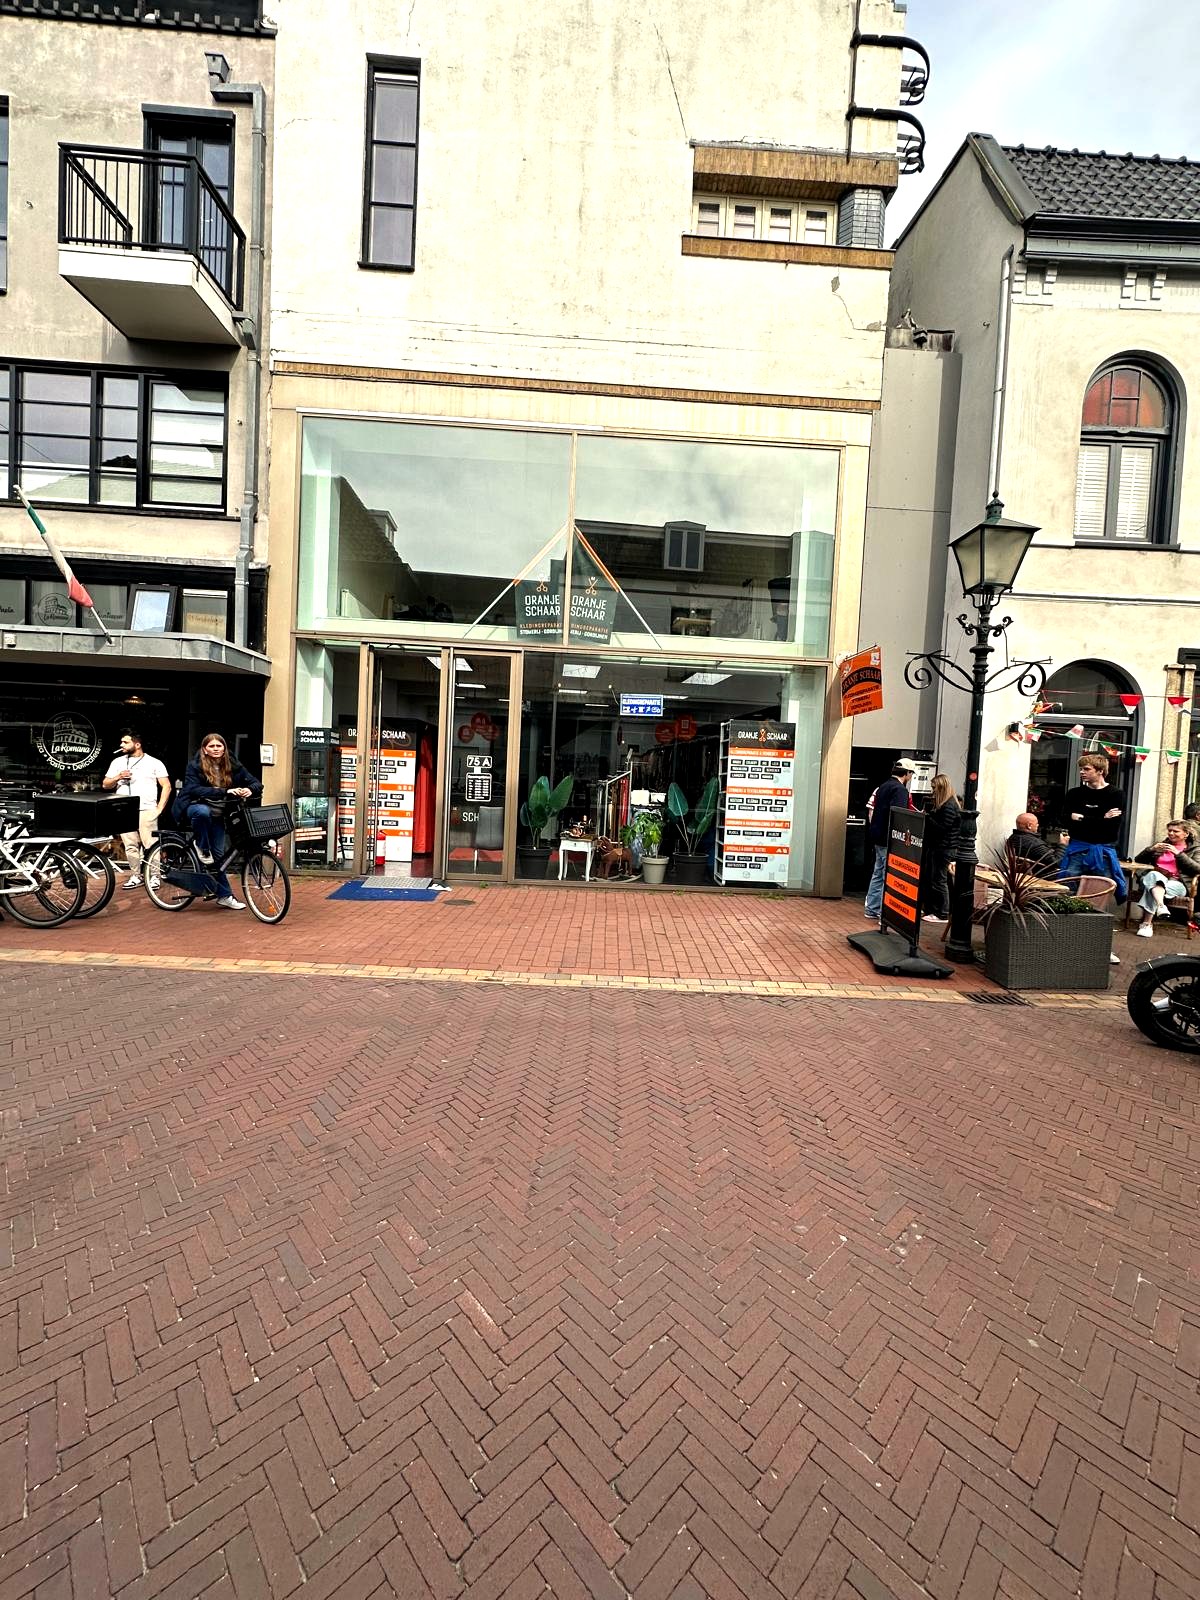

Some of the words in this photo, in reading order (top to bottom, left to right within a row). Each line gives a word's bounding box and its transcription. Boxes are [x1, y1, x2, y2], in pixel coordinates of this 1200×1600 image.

[524, 594, 560, 606] ORANJE
[572, 595, 607, 610] ORANJE
[525, 605, 561, 616] SCHAAR
[570, 606, 606, 621] SCHAAR
[348, 728, 358, 737] OR
[382, 730, 407, 740] SCHAAR
[737, 730, 758, 740] ORANJE
[766, 732, 788, 741] SCHAAR
[51, 743, 60, 753] La
[61, 742, 91, 753] Romana
[46, 756, 65, 771] Pasta
[468, 757, 480, 766] 75
[482, 757, 491, 767] A
